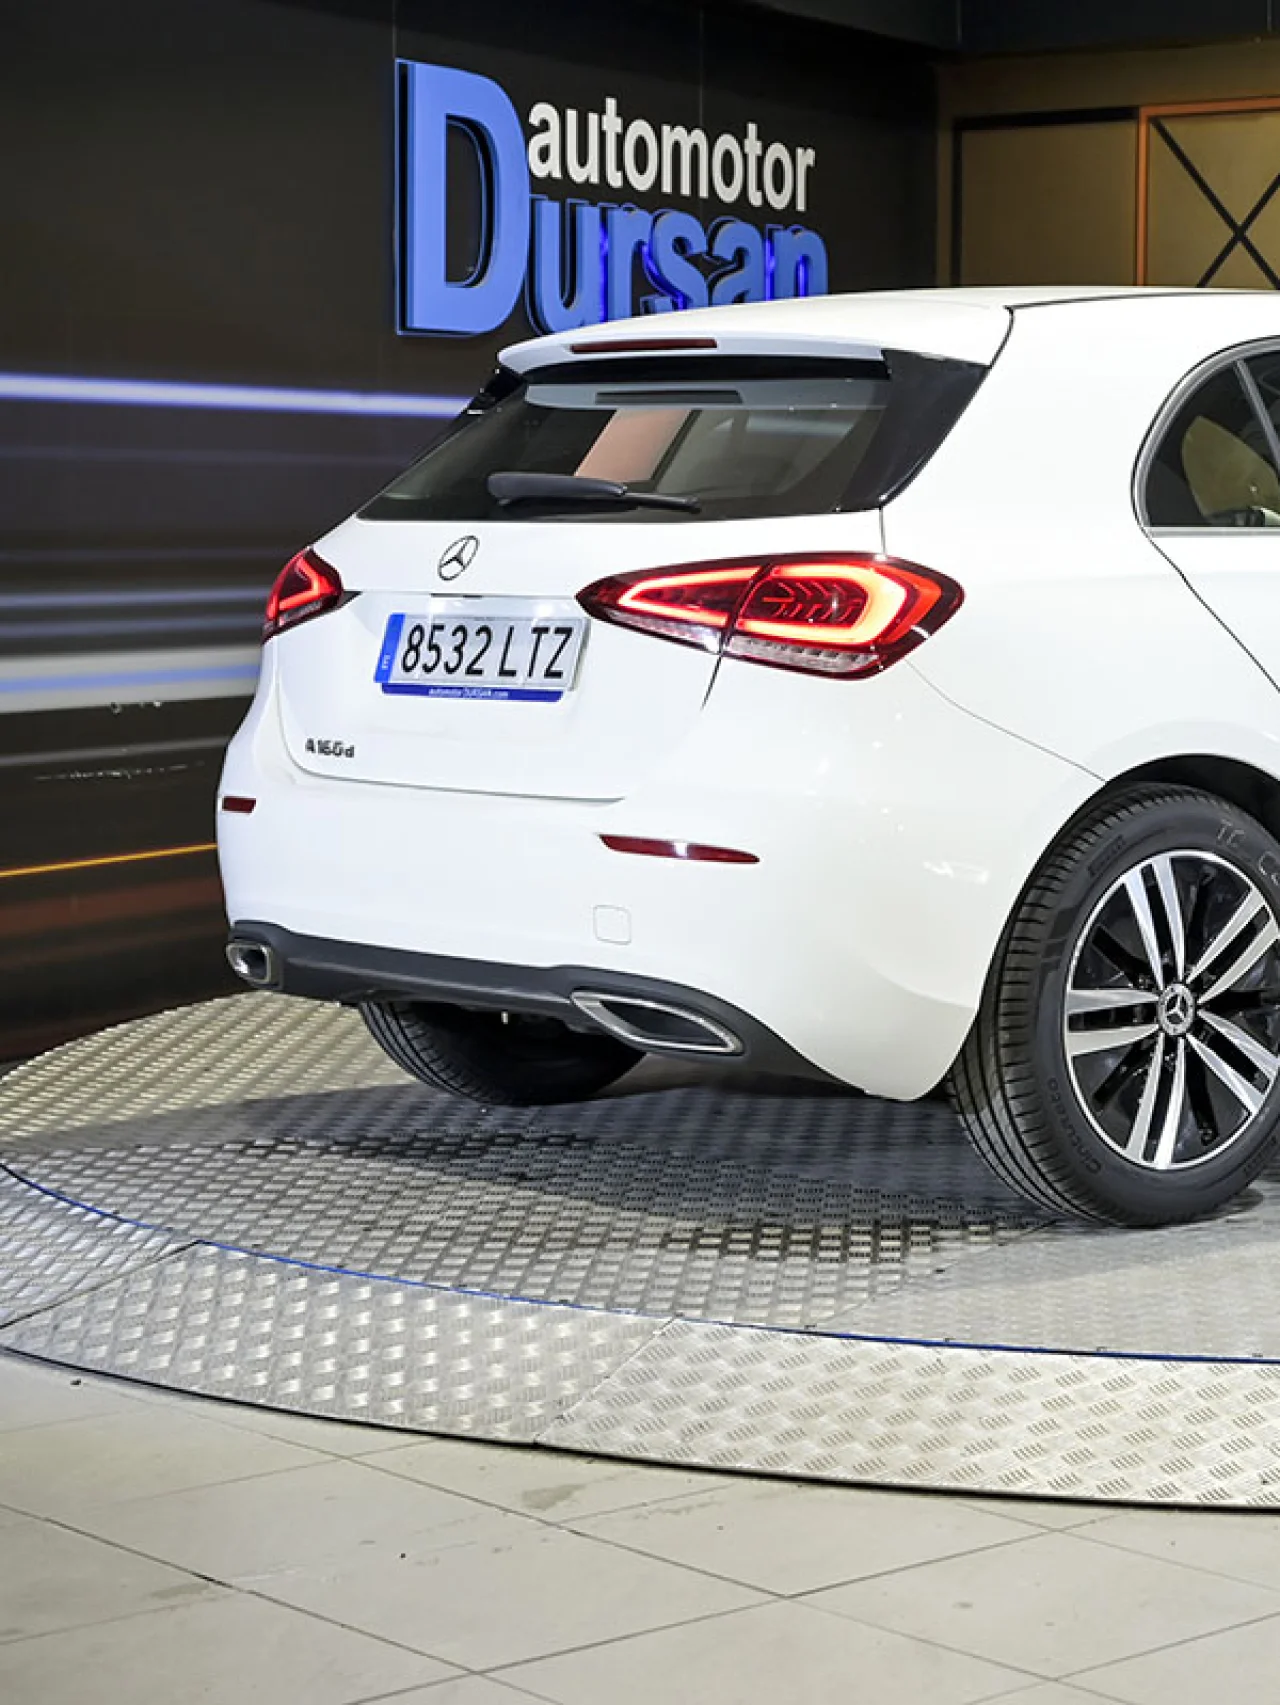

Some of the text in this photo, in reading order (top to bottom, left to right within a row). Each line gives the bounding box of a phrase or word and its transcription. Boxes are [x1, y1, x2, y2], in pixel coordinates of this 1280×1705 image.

[395, 57, 829, 336] Dursan
[528, 97, 815, 212] automotor
[402, 623, 574, 679] 8532 LTZ
